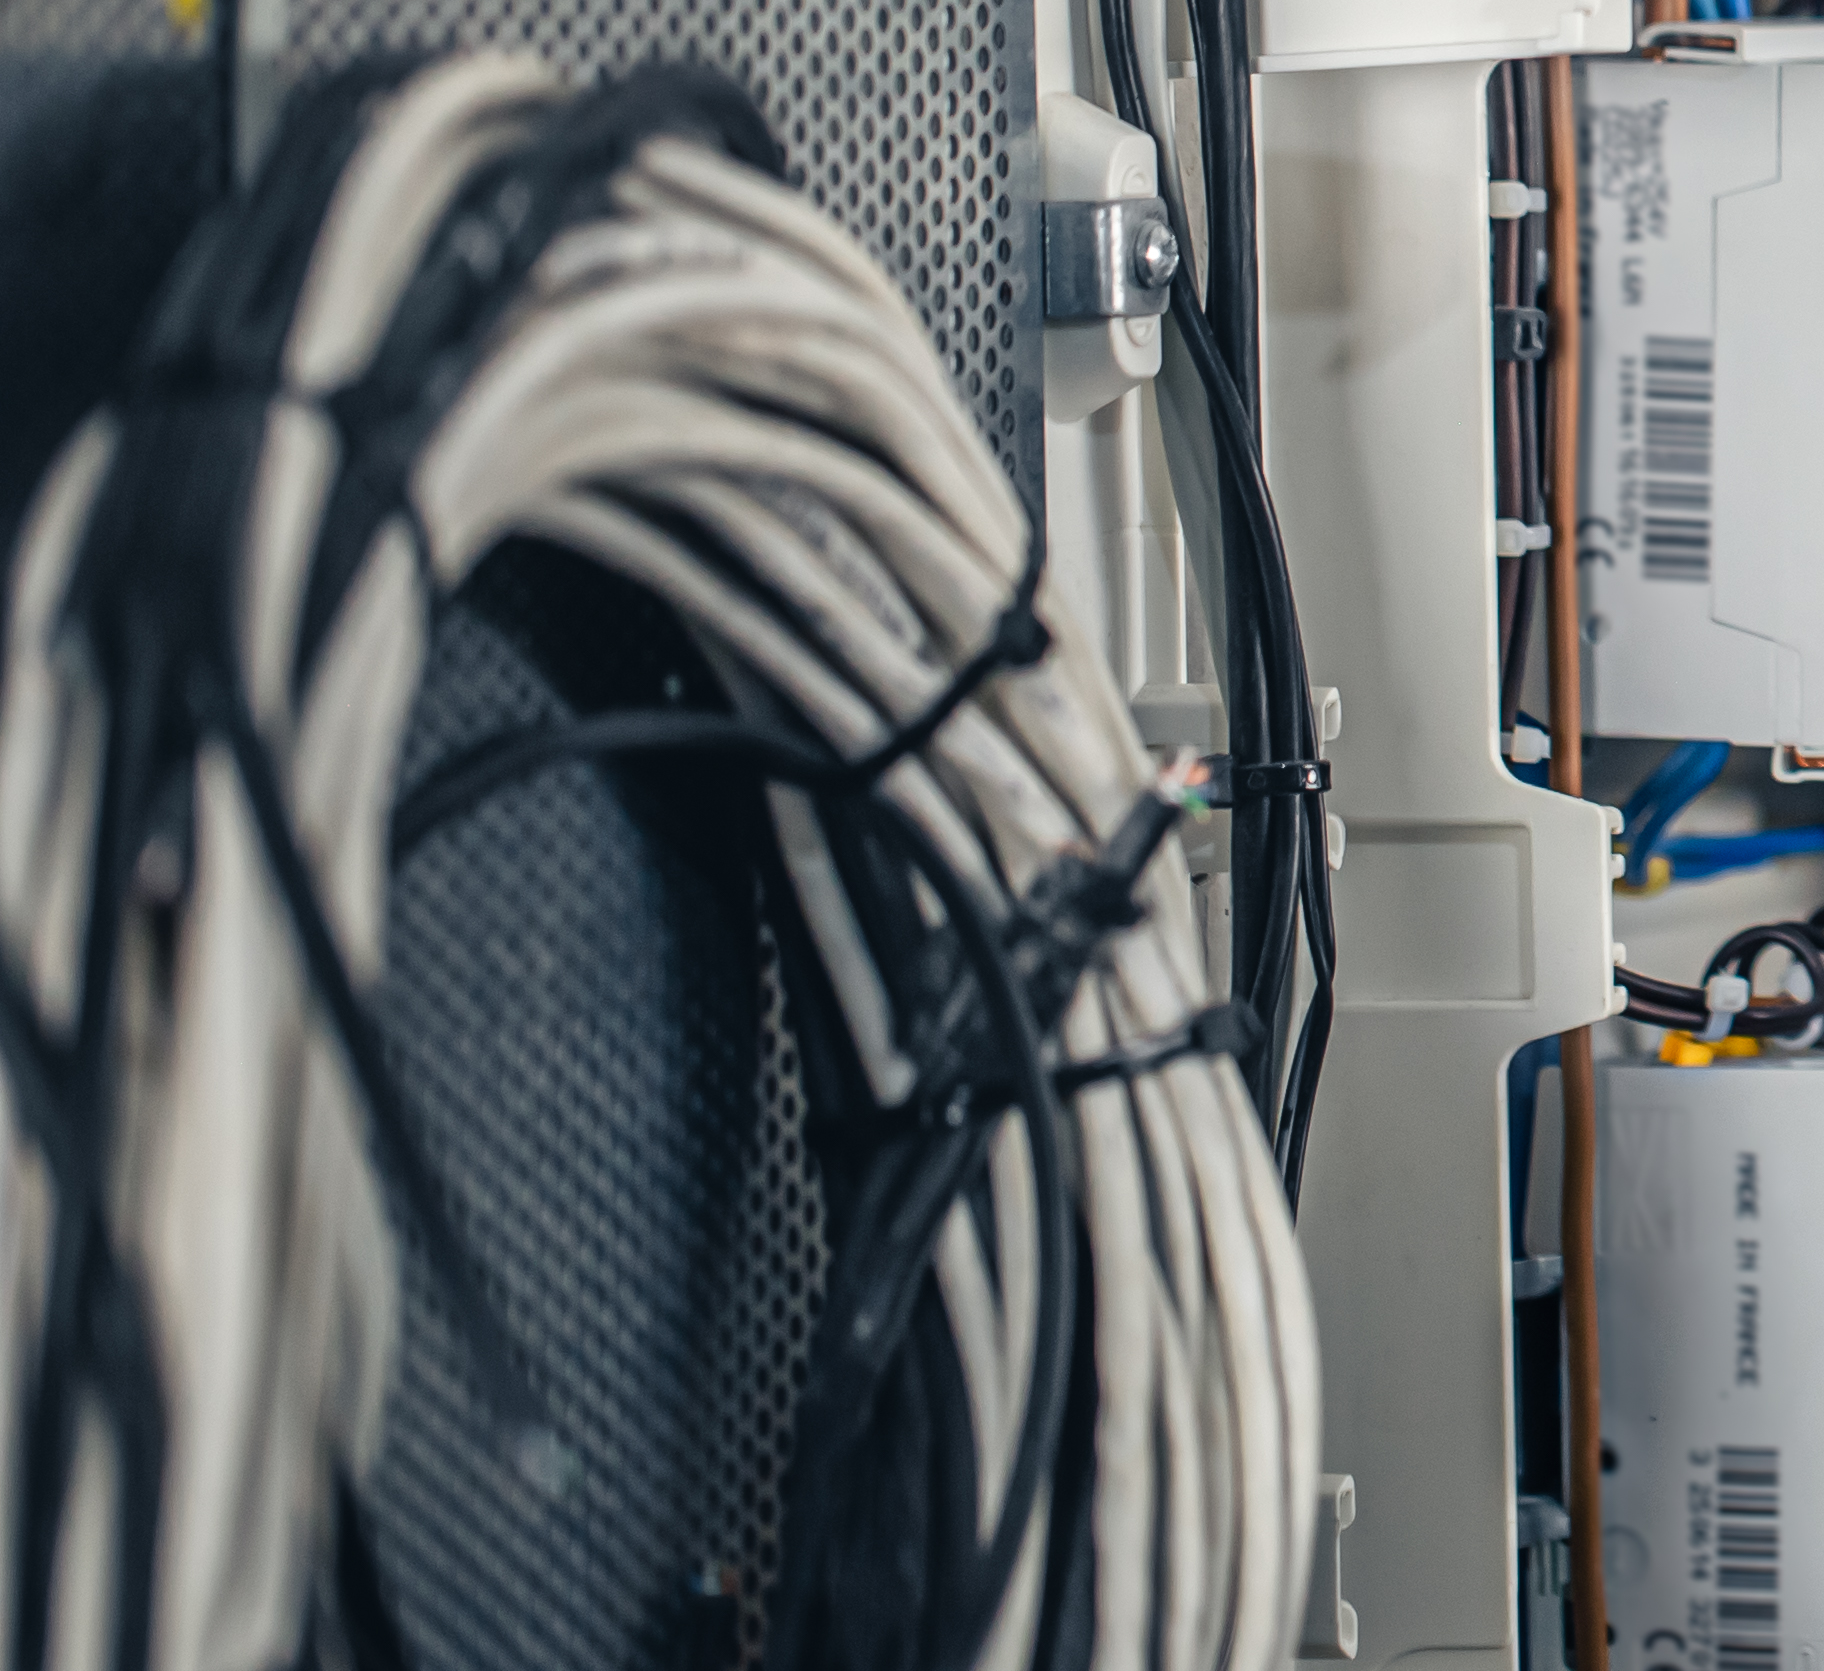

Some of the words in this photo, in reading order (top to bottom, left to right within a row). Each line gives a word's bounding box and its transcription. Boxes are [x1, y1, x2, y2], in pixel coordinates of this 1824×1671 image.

[1736, 1152, 1760, 1219] MADE
[1736, 1239, 1760, 1273] IN
[1736, 1283, 1761, 1387] FRANCE
